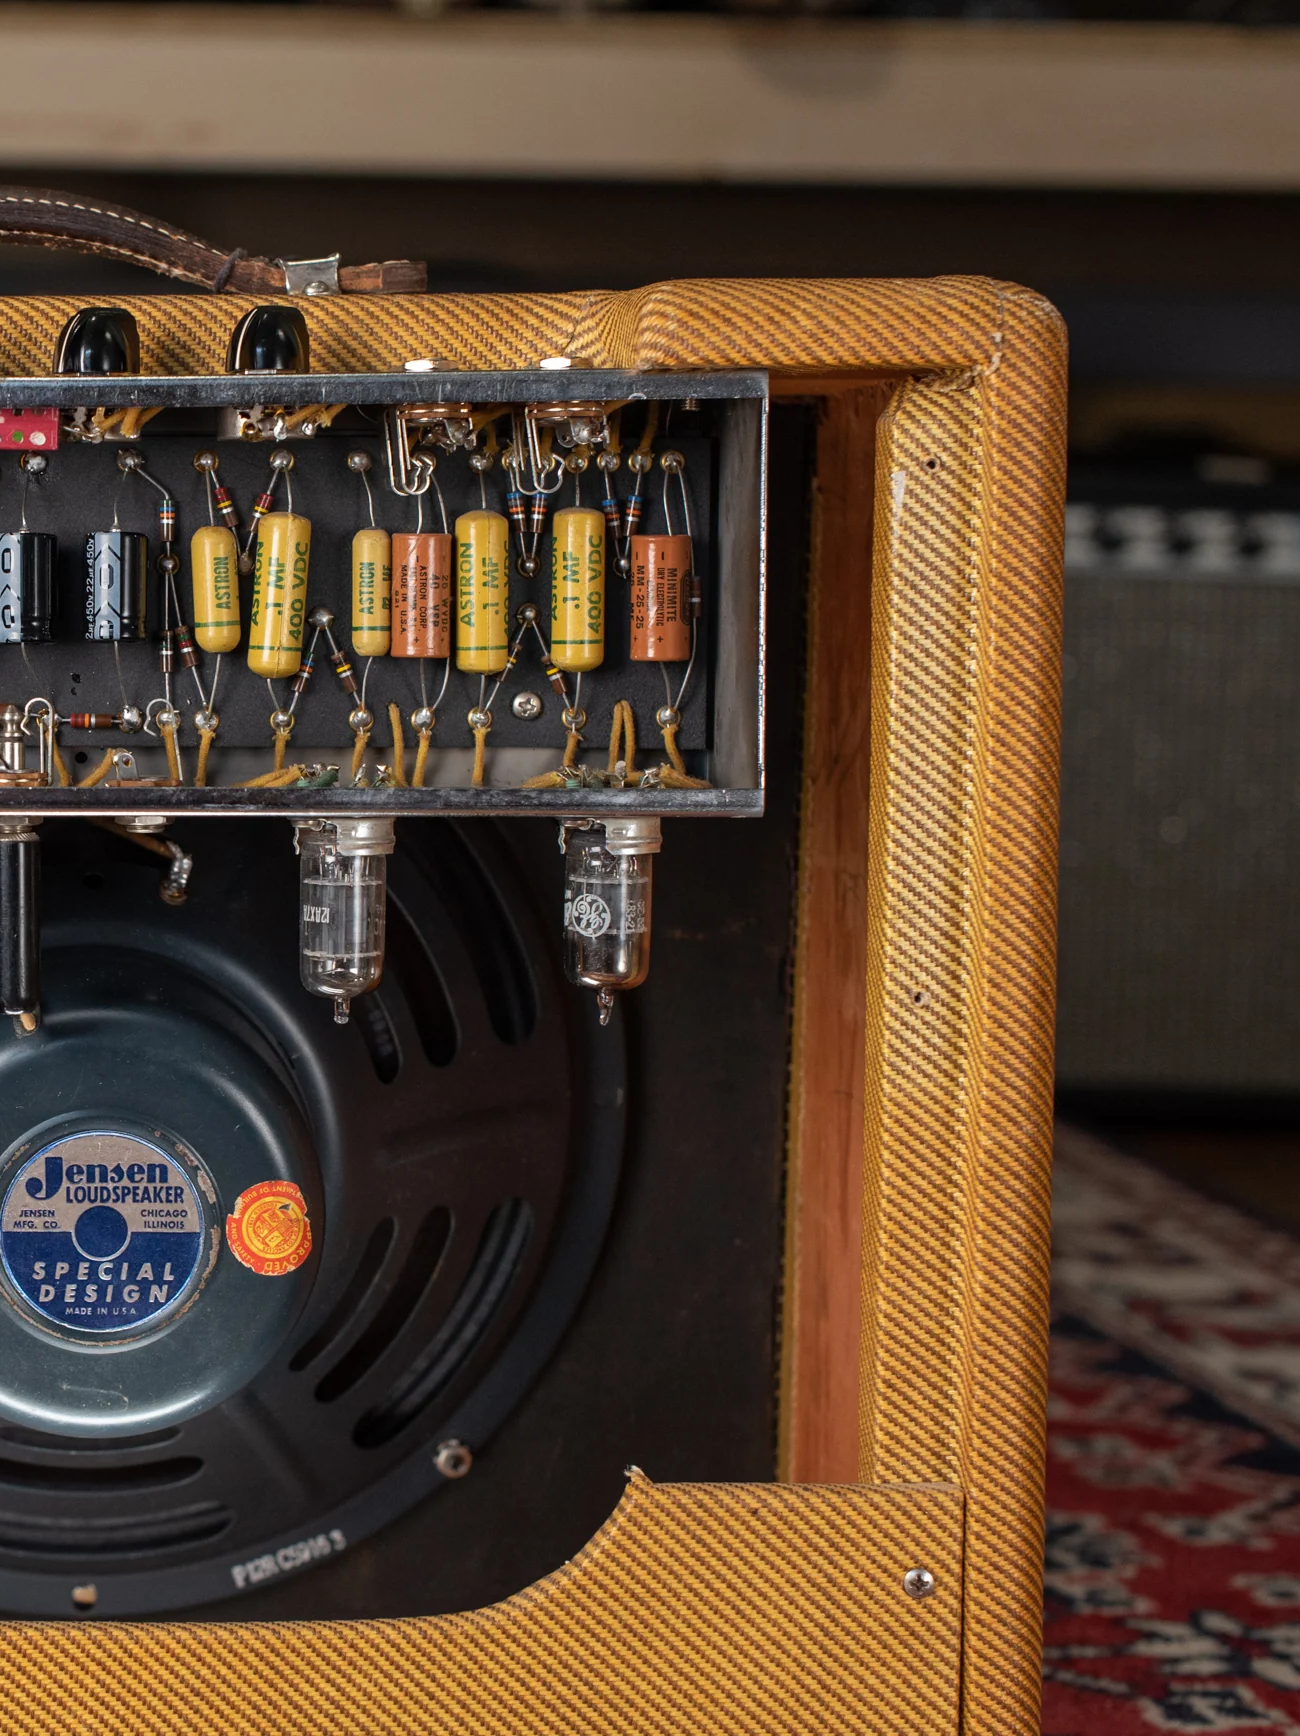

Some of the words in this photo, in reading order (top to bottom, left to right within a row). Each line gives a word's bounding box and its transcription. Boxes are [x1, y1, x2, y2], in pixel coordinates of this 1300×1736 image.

[267, 556, 285, 589] MF
[292, 541, 308, 589] VDC
[482, 557, 499, 589] MF
[563, 551, 579, 583] MF
[588, 535, 602, 583] VDC
[657, 568, 665, 579] DRY
[213, 556, 231, 609] ASTRON
[359, 562, 375, 615] ASTRON
[401, 593, 407, 602] IN
[460, 543, 474, 627] ASTRON
[666, 568, 677, 622] MINIMITE
[289, 599, 303, 641] 400
[418, 606, 427, 631] CORP.
[587, 591, 602, 634] 400
[656, 583, 665, 626] ELECTROLYTIC
[25, 1156, 168, 1200] Jensen
[65, 1186, 184, 1204] LOUDSPEAKER
[13, 1220, 37, 1229] MFG.
[42, 1220, 61, 1229] CO.
[19, 1208, 56, 1218] JENSEN
[140, 1208, 188, 1218] CHICAGO
[143, 1220, 185, 1230] ILLINOIS
[265, 1232, 311, 1270] PPROVED
[32, 1262, 175, 1281] SPECIAL
[39, 1284, 170, 1303] DESIGN
[65, 1307, 92, 1315] MADE
[96, 1307, 108, 1315] IN
